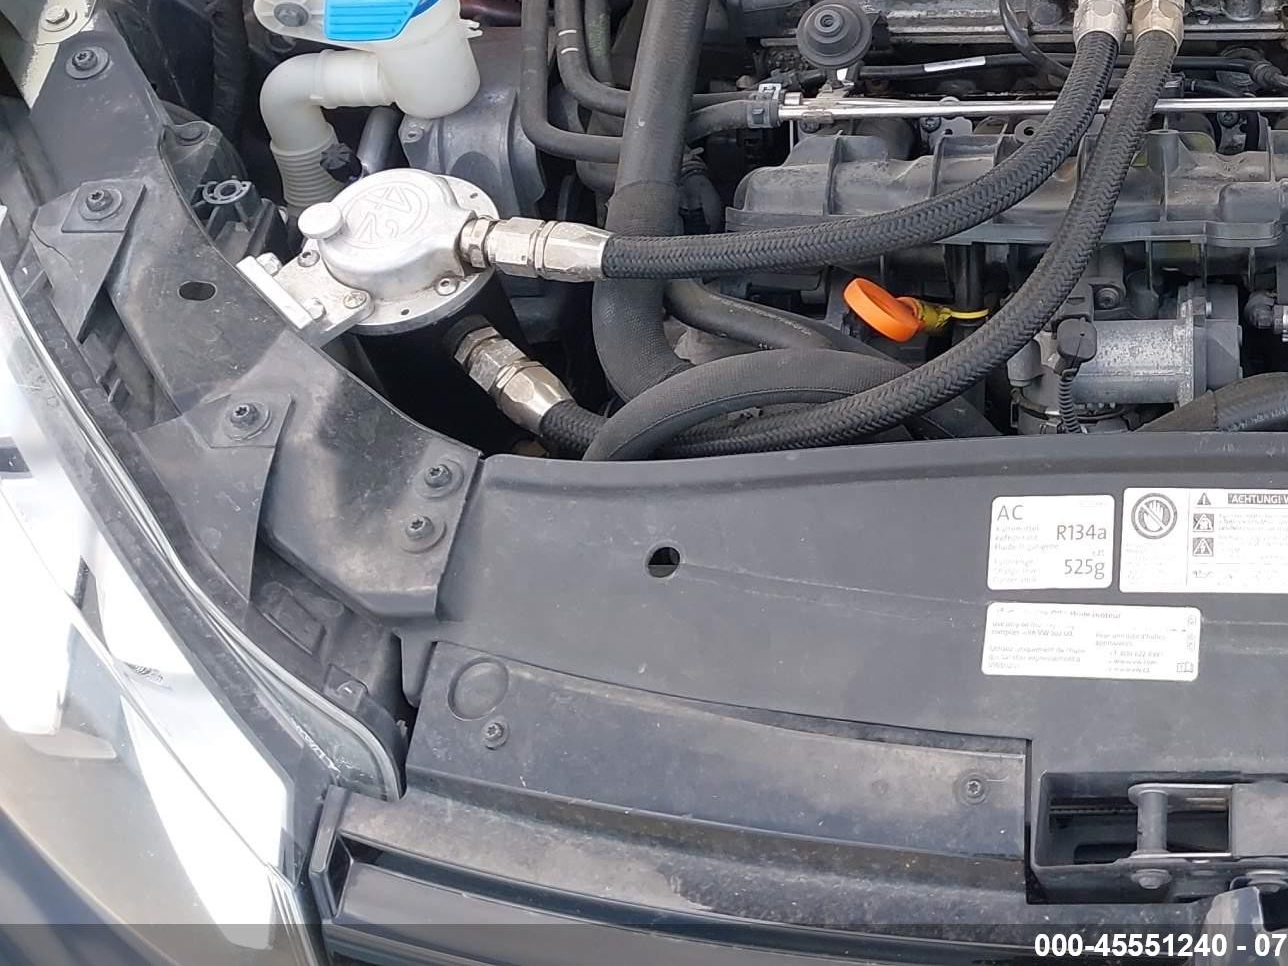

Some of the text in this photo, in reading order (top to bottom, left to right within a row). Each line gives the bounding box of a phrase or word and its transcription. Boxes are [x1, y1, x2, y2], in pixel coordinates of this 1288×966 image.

[1231, 494, 1282, 505] ACHTUNG!
[996, 504, 1025, 522] AC
[1056, 523, 1108, 542] R134a
[1063, 558, 1106, 581] 525g
